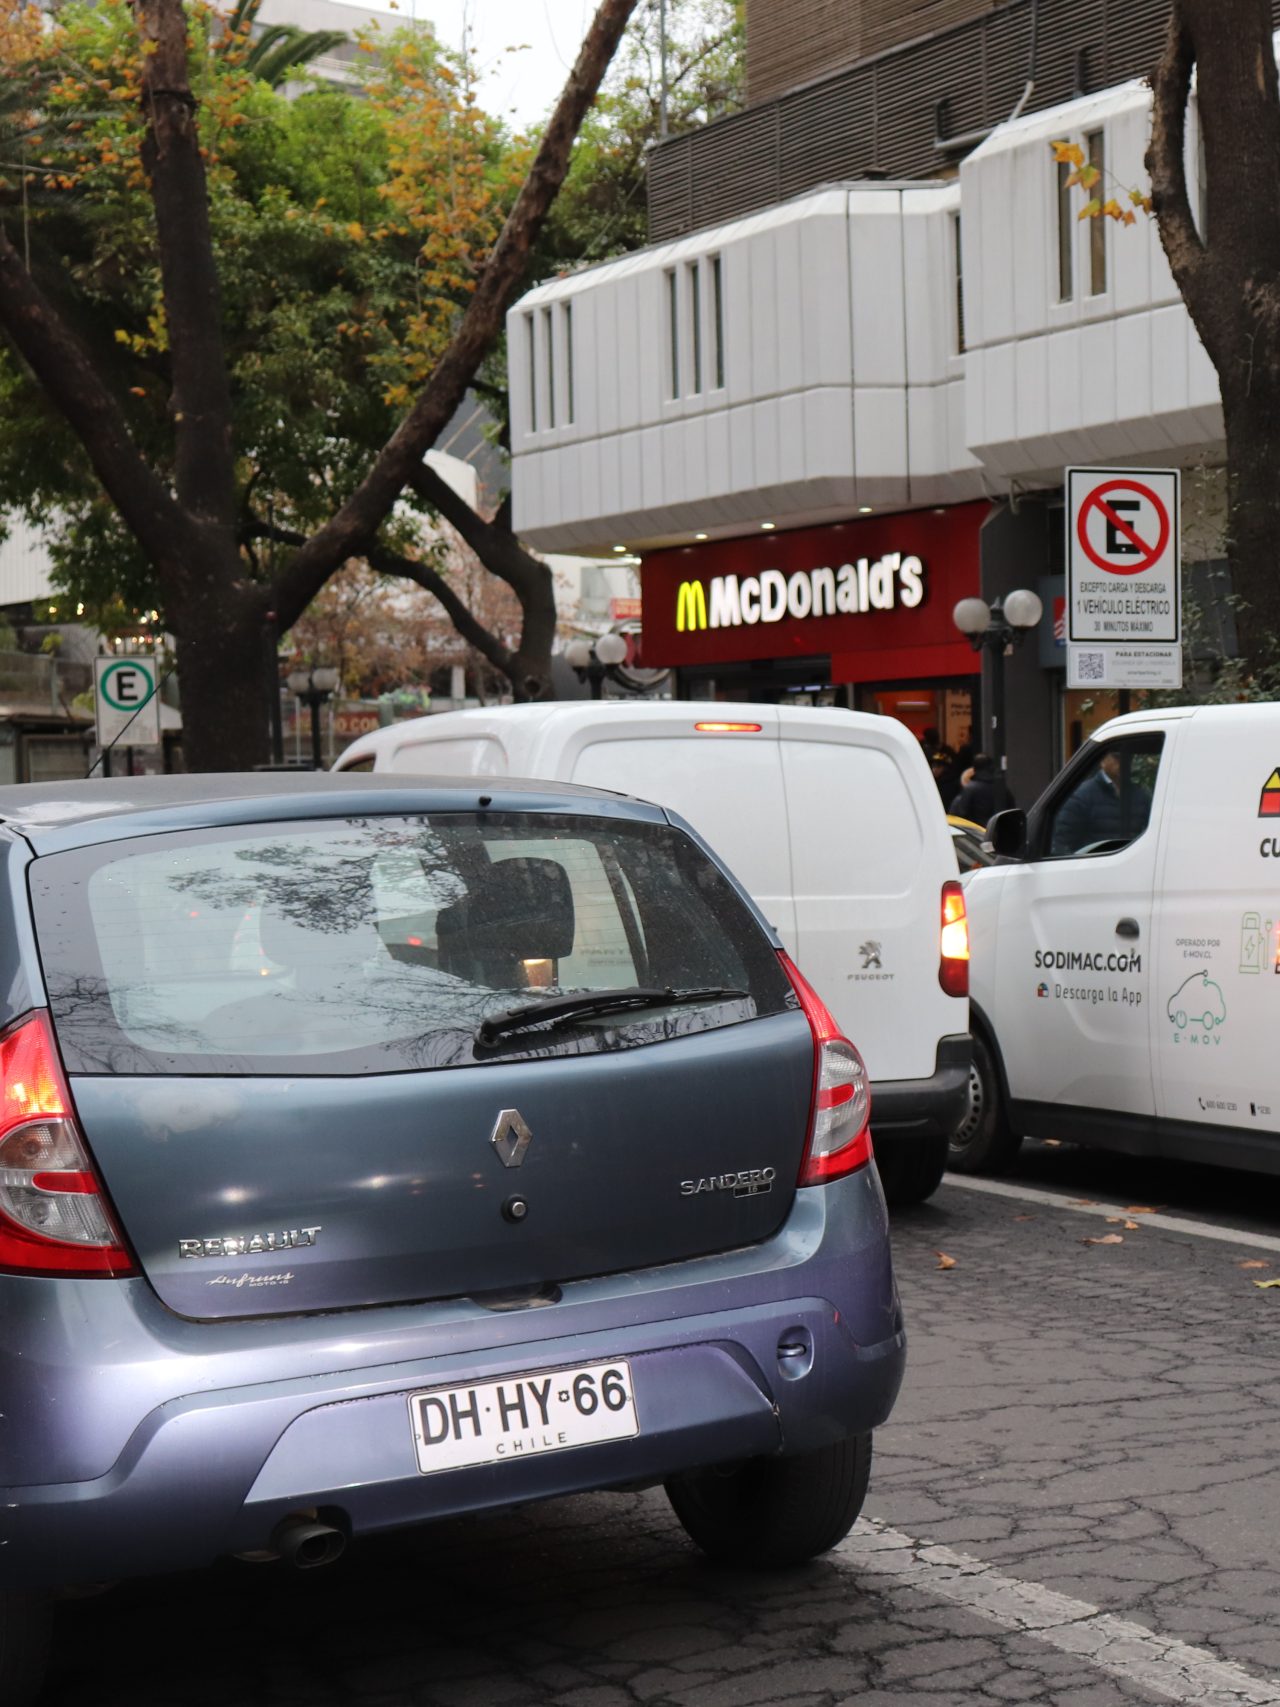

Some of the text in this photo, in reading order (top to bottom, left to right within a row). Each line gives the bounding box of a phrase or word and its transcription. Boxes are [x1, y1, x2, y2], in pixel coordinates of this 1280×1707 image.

[1106, 499, 1141, 554] E
[709, 552, 923, 628] McDonald's
[1080, 582, 1166, 594] EXCEPTO CARGA Y DESCARGA
[1077, 601, 1082, 614] 1
[1103, 621, 1129, 632] MINUTOS
[116, 672, 138, 701] E
[1176, 939, 1220, 948] OPERADO POR
[1035, 950, 1142, 973] SODIMAC.COM
[1055, 983, 1142, 1008] Descarga la App
[680, 1166, 776, 1196] SANDERO
[178, 1226, 322, 1258] RENAULT
[496, 1432, 568, 1455] CHILE
